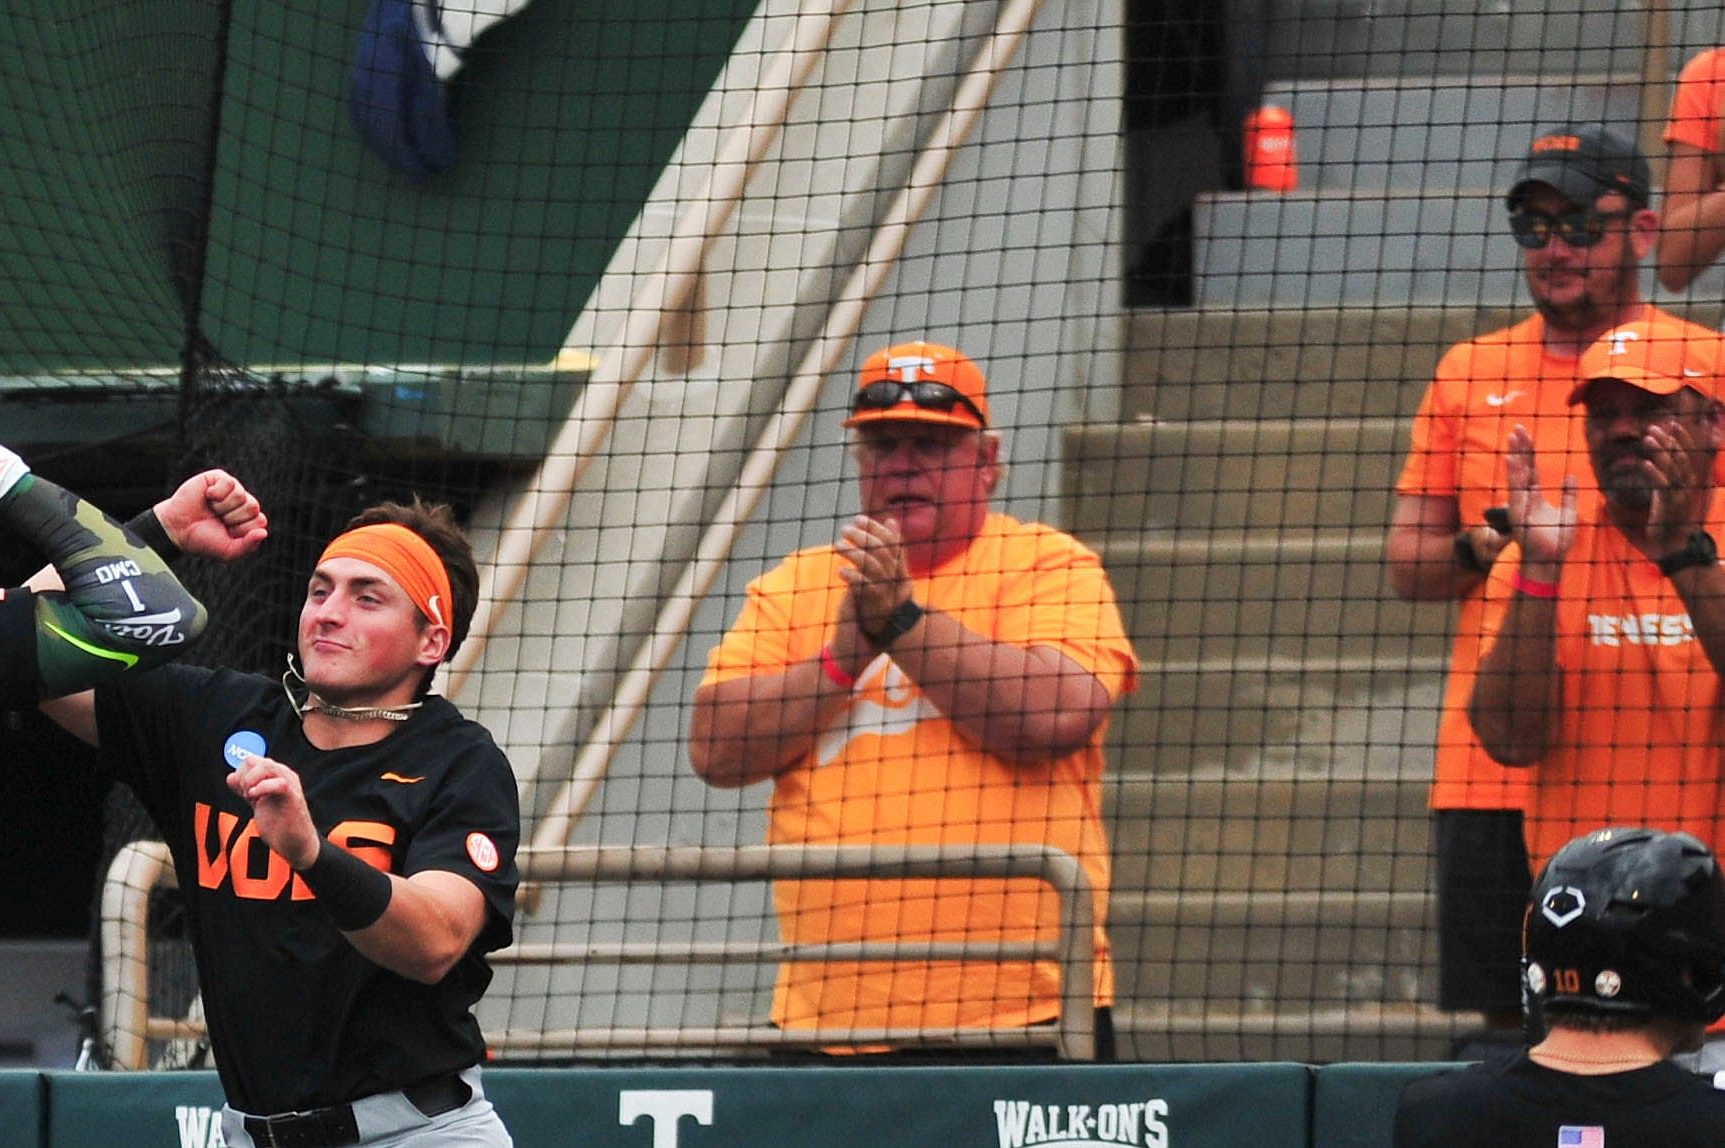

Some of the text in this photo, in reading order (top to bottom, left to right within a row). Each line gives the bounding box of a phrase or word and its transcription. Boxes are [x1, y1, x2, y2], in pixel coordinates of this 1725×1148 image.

[121, 580, 146, 612] 1
[194, 802, 396, 901] VOS
[1553, 968, 1581, 993] 10
